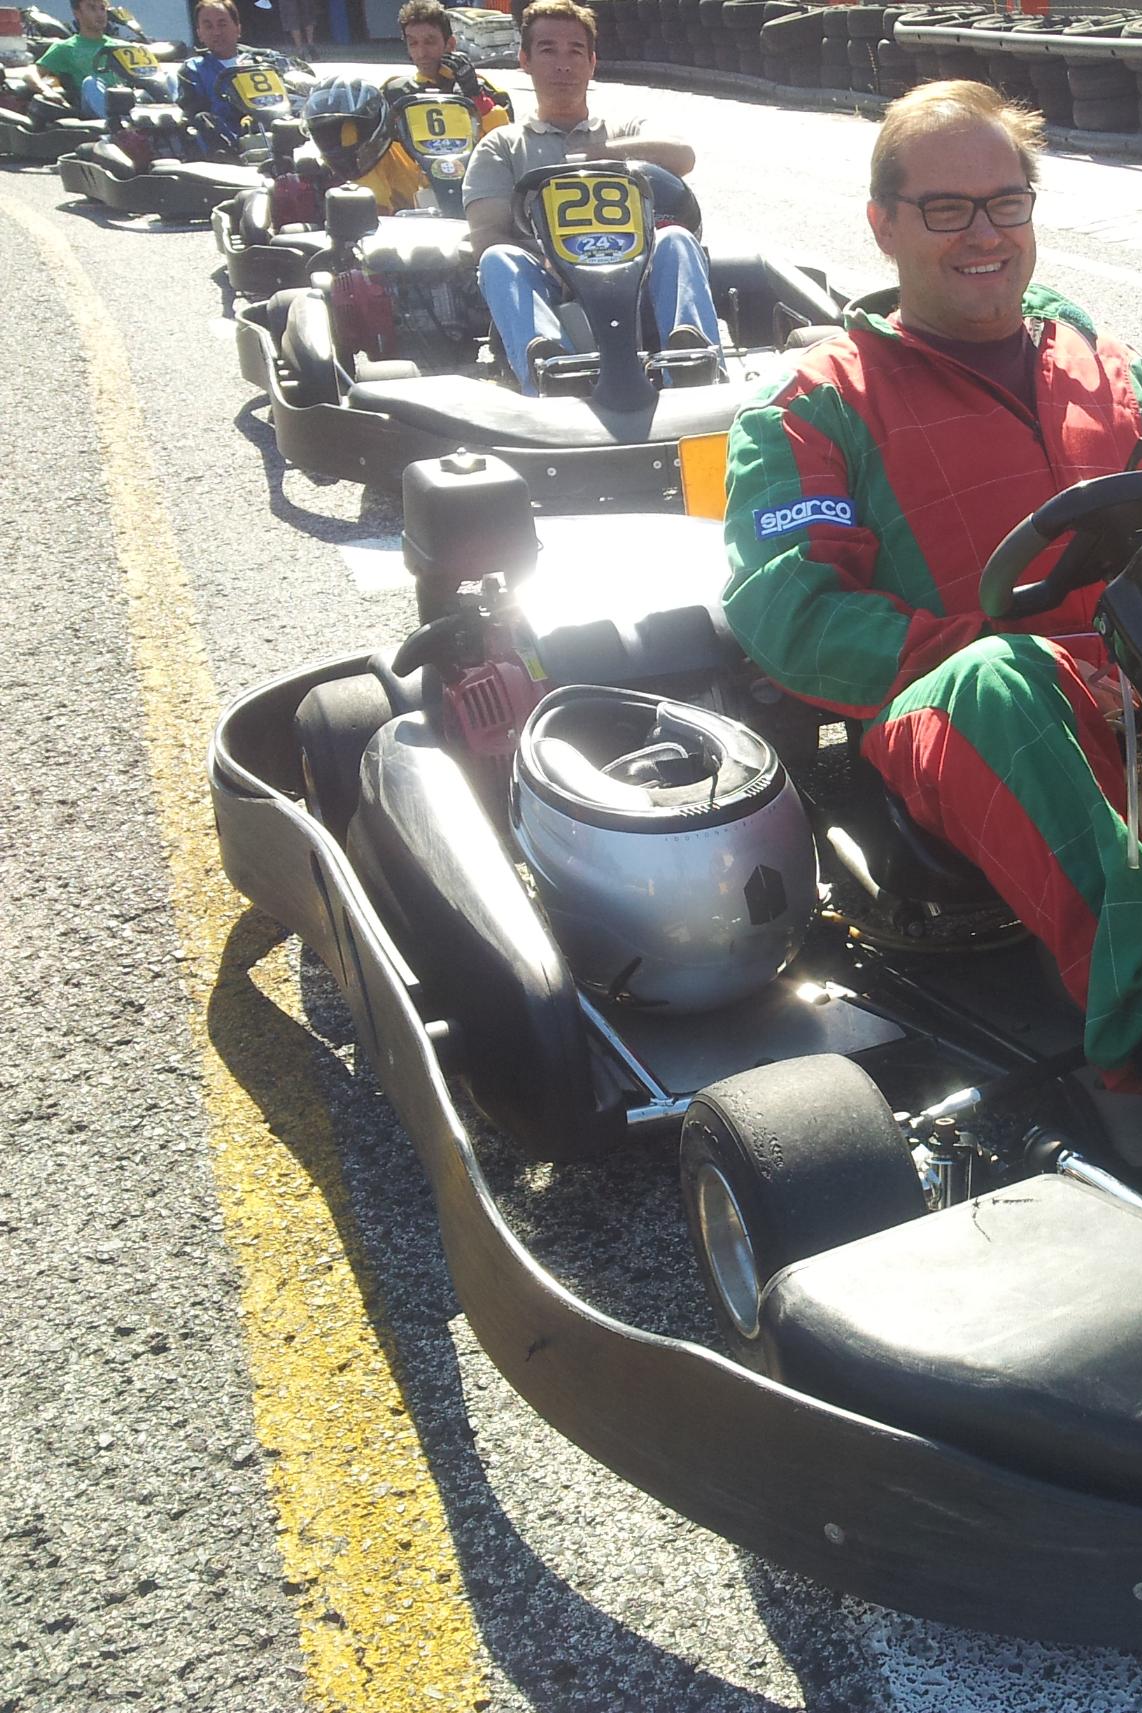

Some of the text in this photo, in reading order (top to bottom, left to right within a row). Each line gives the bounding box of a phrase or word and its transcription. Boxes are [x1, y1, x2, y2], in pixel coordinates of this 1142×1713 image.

[250, 72, 273, 92] 8
[426, 108, 446, 136] 6
[555, 181, 631, 227] 28
[582, 236, 611, 251] 24
[760, 500, 851, 531] sparco
